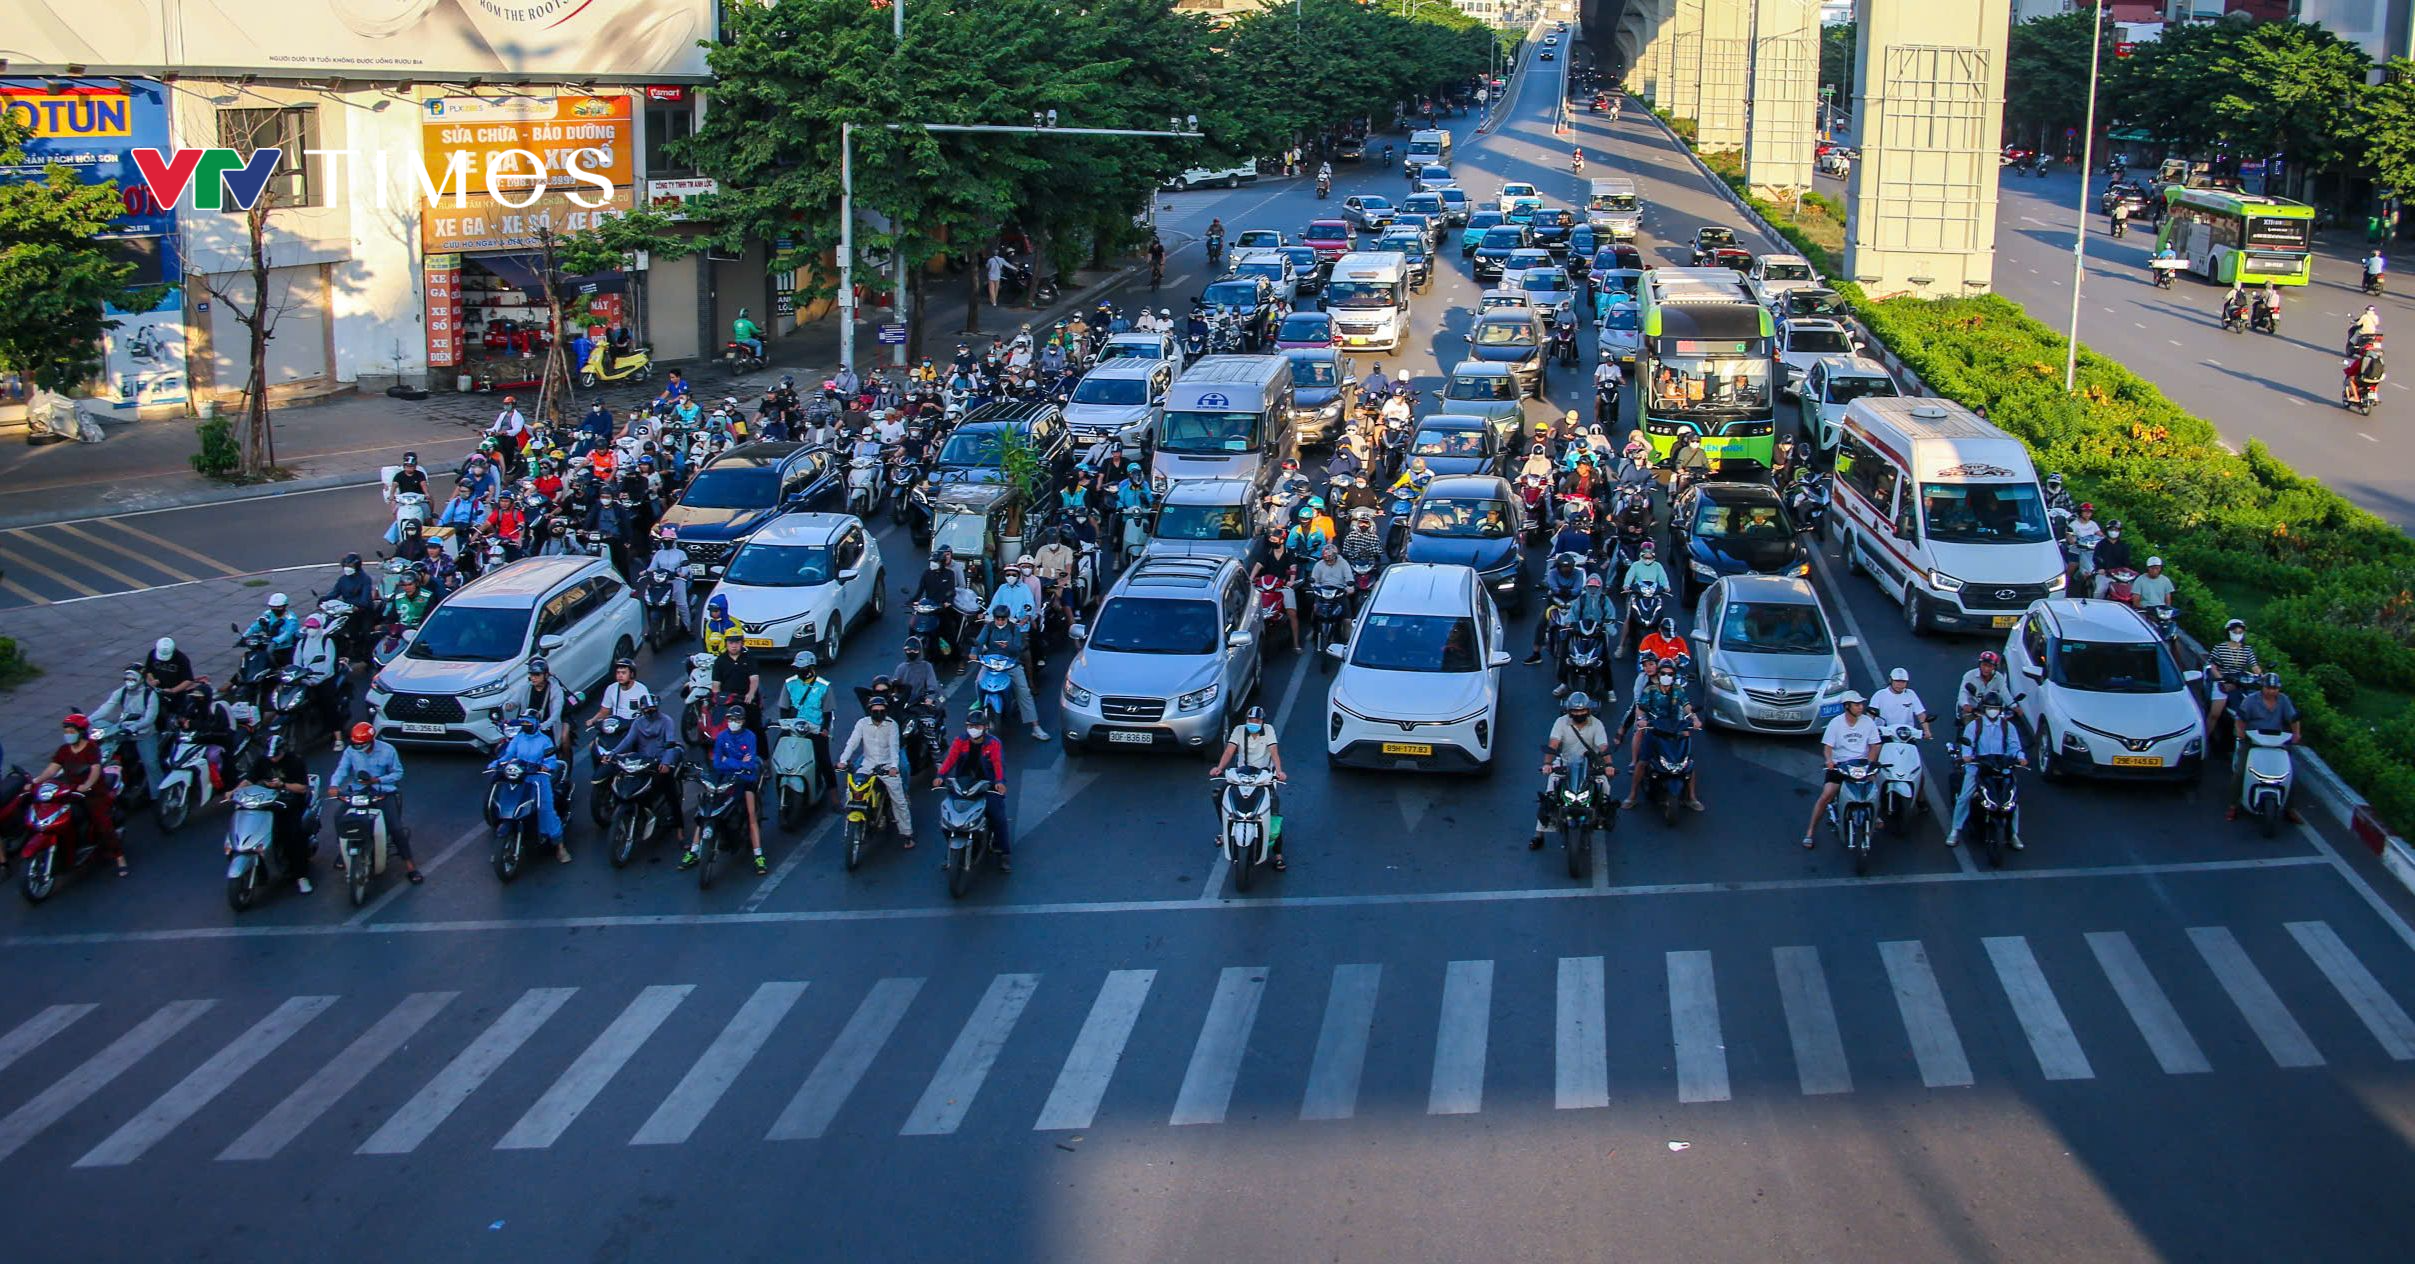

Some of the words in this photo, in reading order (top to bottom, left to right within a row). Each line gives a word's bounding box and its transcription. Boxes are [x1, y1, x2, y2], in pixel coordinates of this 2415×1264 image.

[480, 0, 501, 17] ROM
[504, 9, 525, 21] THE
[0, 100, 126, 133] OTUN
[442, 125, 473, 144] SỬA
[477, 122, 518, 143] CHỮA
[532, 121, 562, 142] BẢO
[566, 121, 615, 140] DƯỠNG
[434, 218, 457, 238] XE
[462, 216, 485, 236] GA
[502, 214, 523, 235] XE
[431, 274, 447, 284] XE
[430, 288, 447, 297] GA
[590, 298, 609, 310] MÁY
[431, 307, 448, 316] XE
[431, 339, 448, 348] XE
